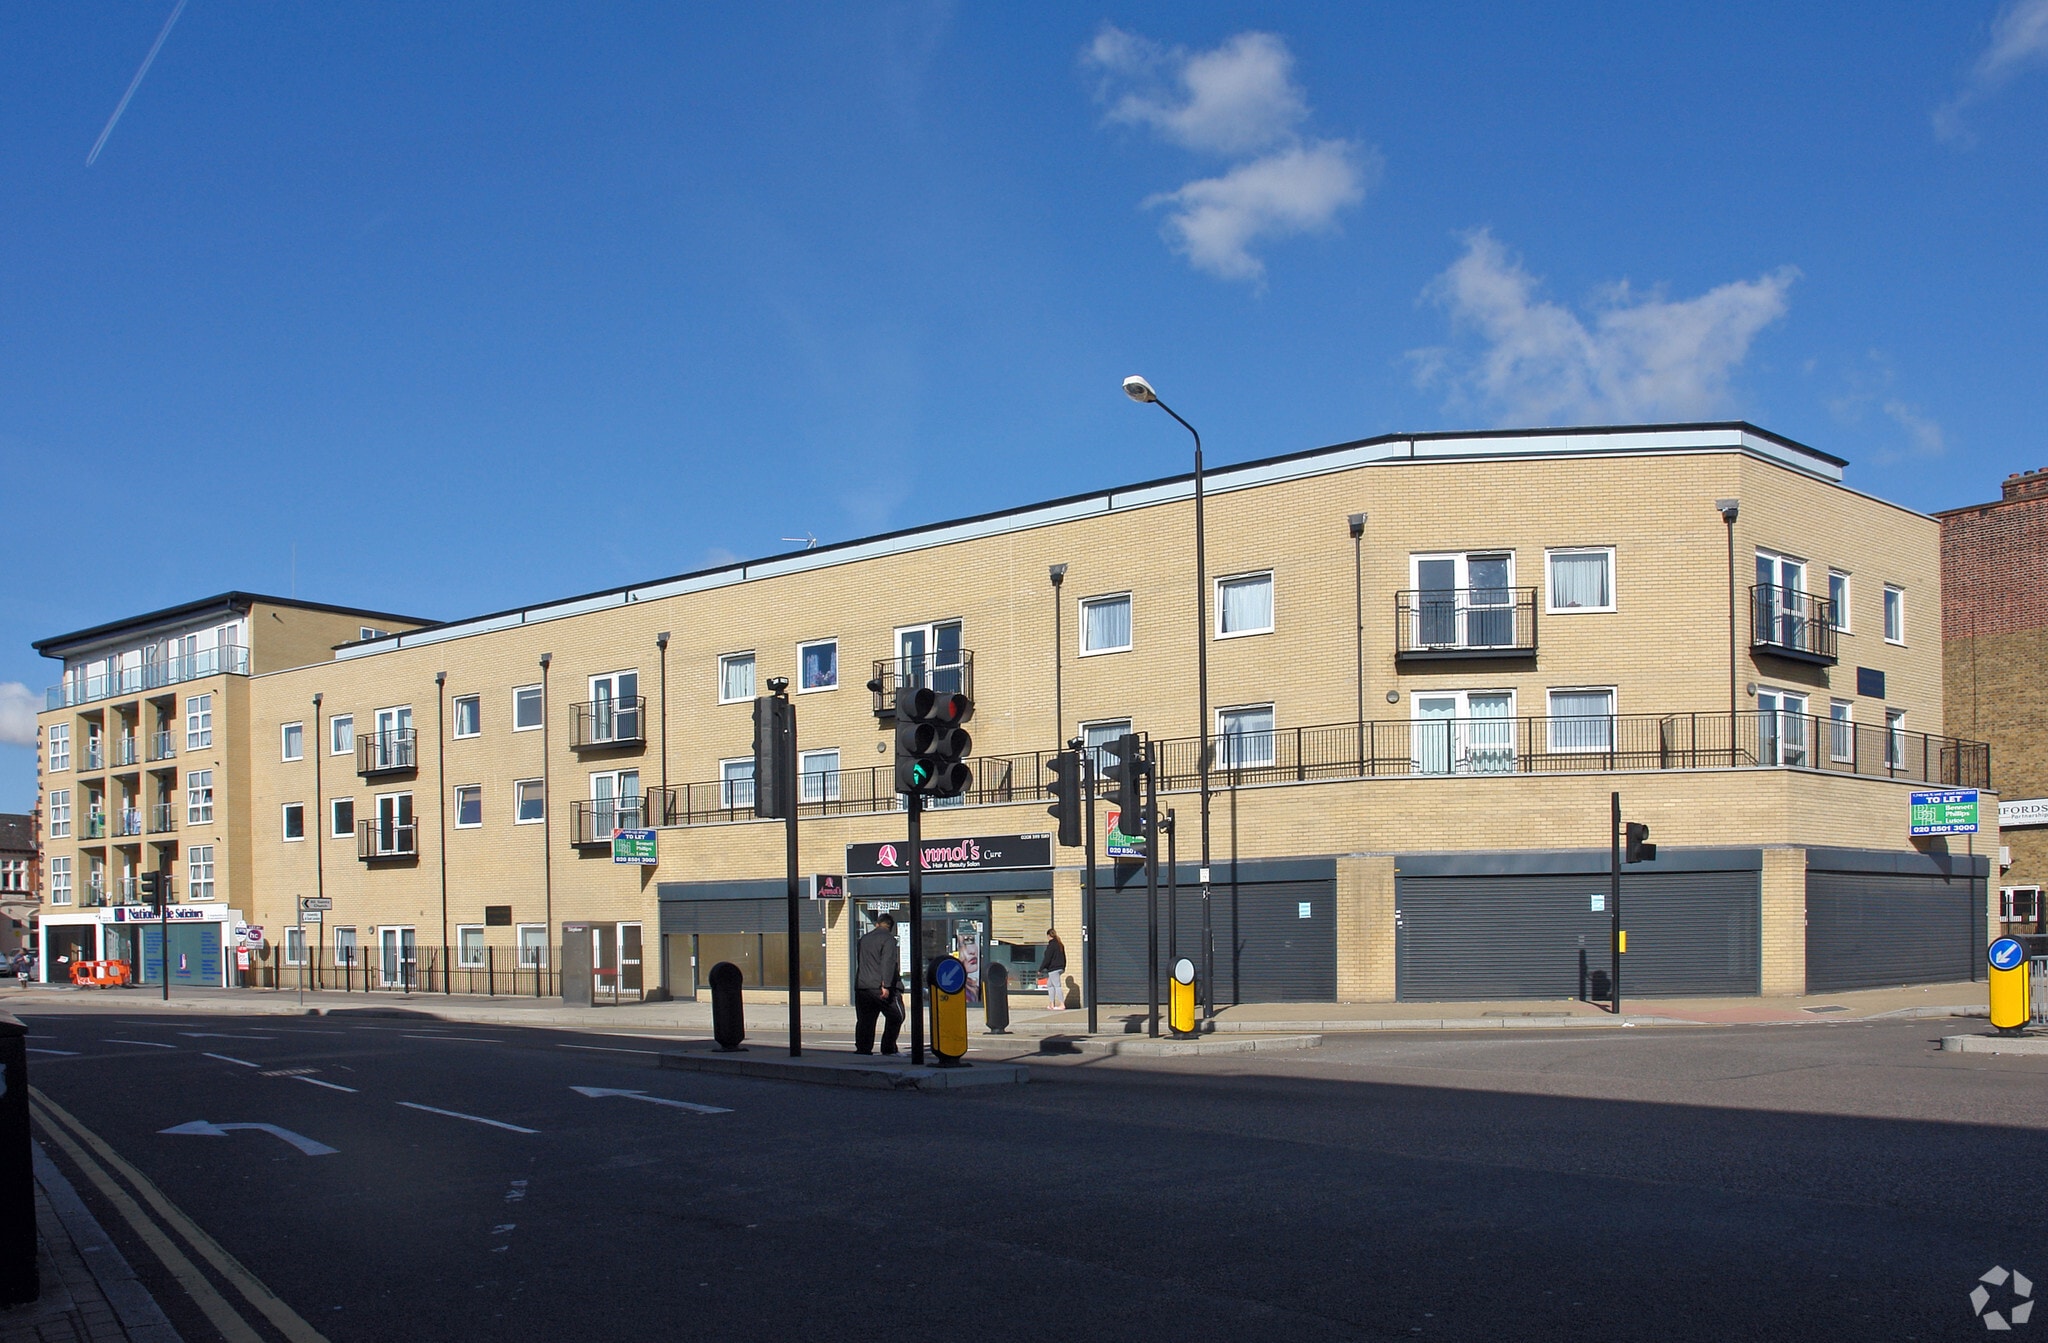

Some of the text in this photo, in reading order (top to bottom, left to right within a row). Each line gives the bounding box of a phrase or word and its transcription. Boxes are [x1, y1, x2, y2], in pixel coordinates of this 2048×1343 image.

[1943, 795, 1962, 803] LET
[932, 861, 943, 869] Hair
[949, 860, 966, 869] Beauty
[967, 860, 980, 868] Salon
[175, 908, 204, 919] Solicitors
[249, 931, 259, 939] hc
